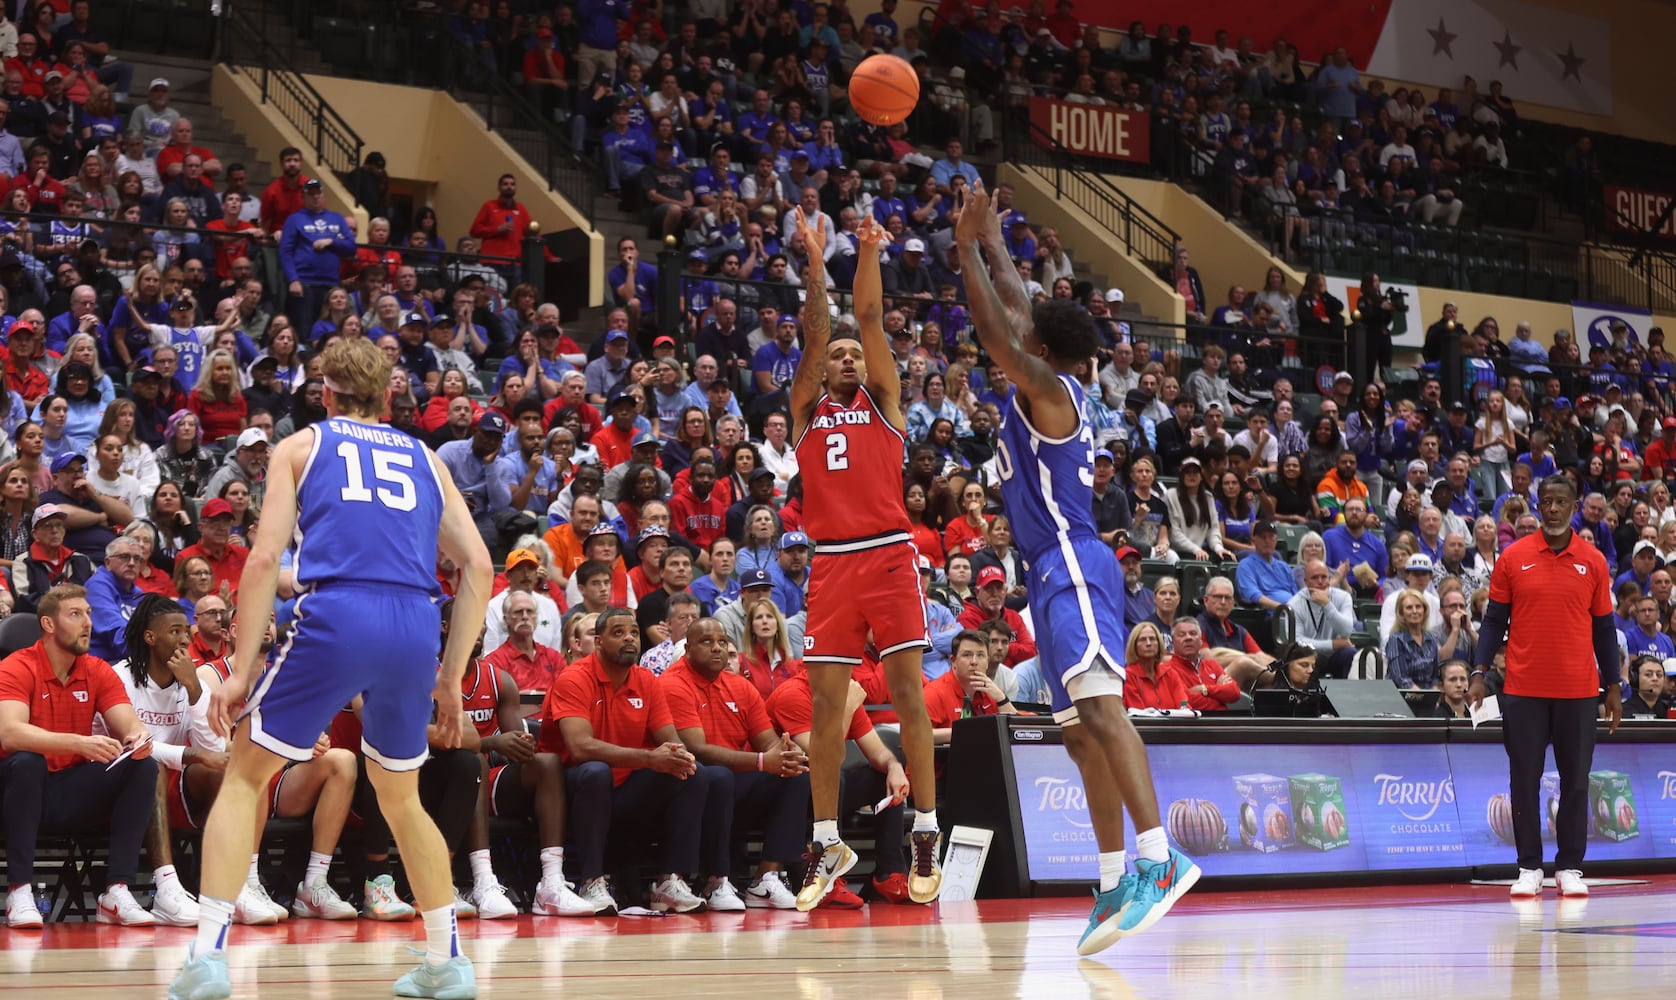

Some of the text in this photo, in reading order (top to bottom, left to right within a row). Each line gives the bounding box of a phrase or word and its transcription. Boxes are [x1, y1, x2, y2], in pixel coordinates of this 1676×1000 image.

[1051, 104, 1130, 156] HOME
[183, 354, 195, 372] 3
[328, 421, 415, 449] SAUNDERS
[825, 432, 849, 471] 2
[336, 440, 418, 512] 15
[1412, 558, 1428, 566] BYU
[1391, 824, 1452, 834] CHOCOLATE
[1387, 846, 1402, 854] TIME
[1416, 845, 1433, 853] HAVE
